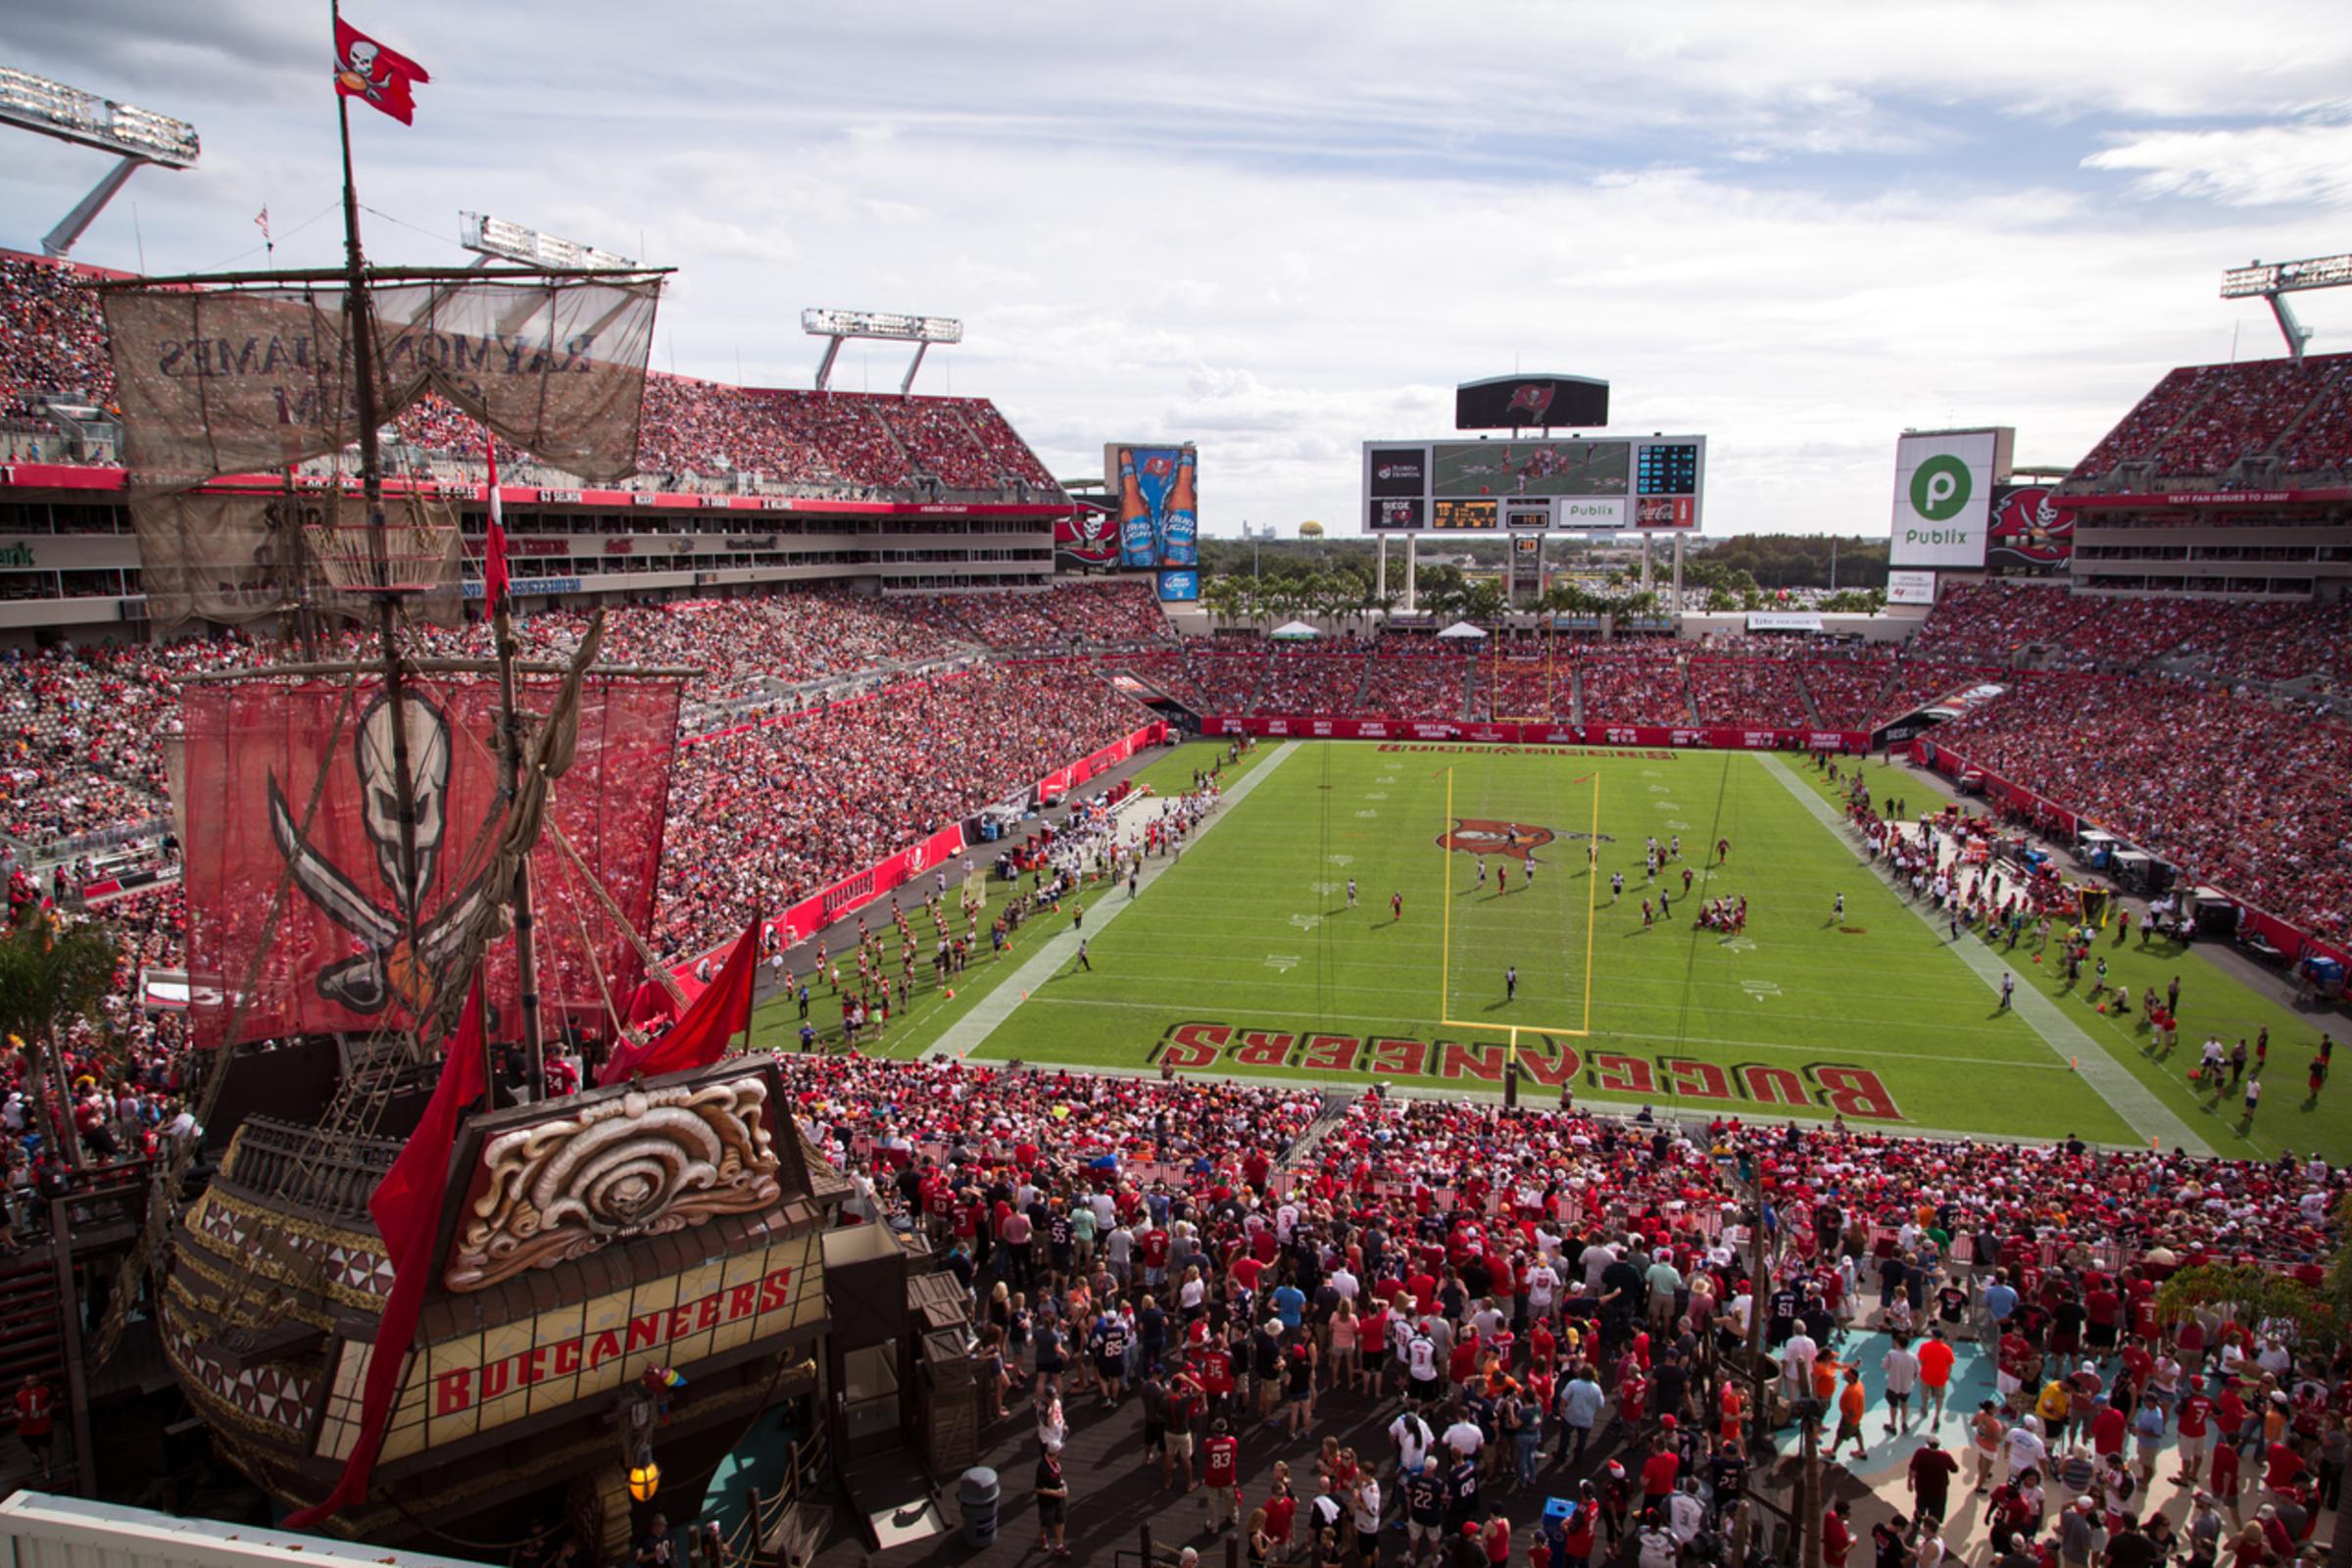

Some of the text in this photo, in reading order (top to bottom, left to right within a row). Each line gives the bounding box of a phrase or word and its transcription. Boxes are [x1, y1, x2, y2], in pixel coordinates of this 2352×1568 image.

[1570, 505, 1614, 516] Publix
[1906, 529, 1968, 545] Publix
[1151, 1021, 1905, 1120] BUCCANEERS
[436, 1266, 792, 1417] BUCCANEERS
[1211, 1452, 1231, 1469] 83
[1413, 1489, 1433, 1510] 22
